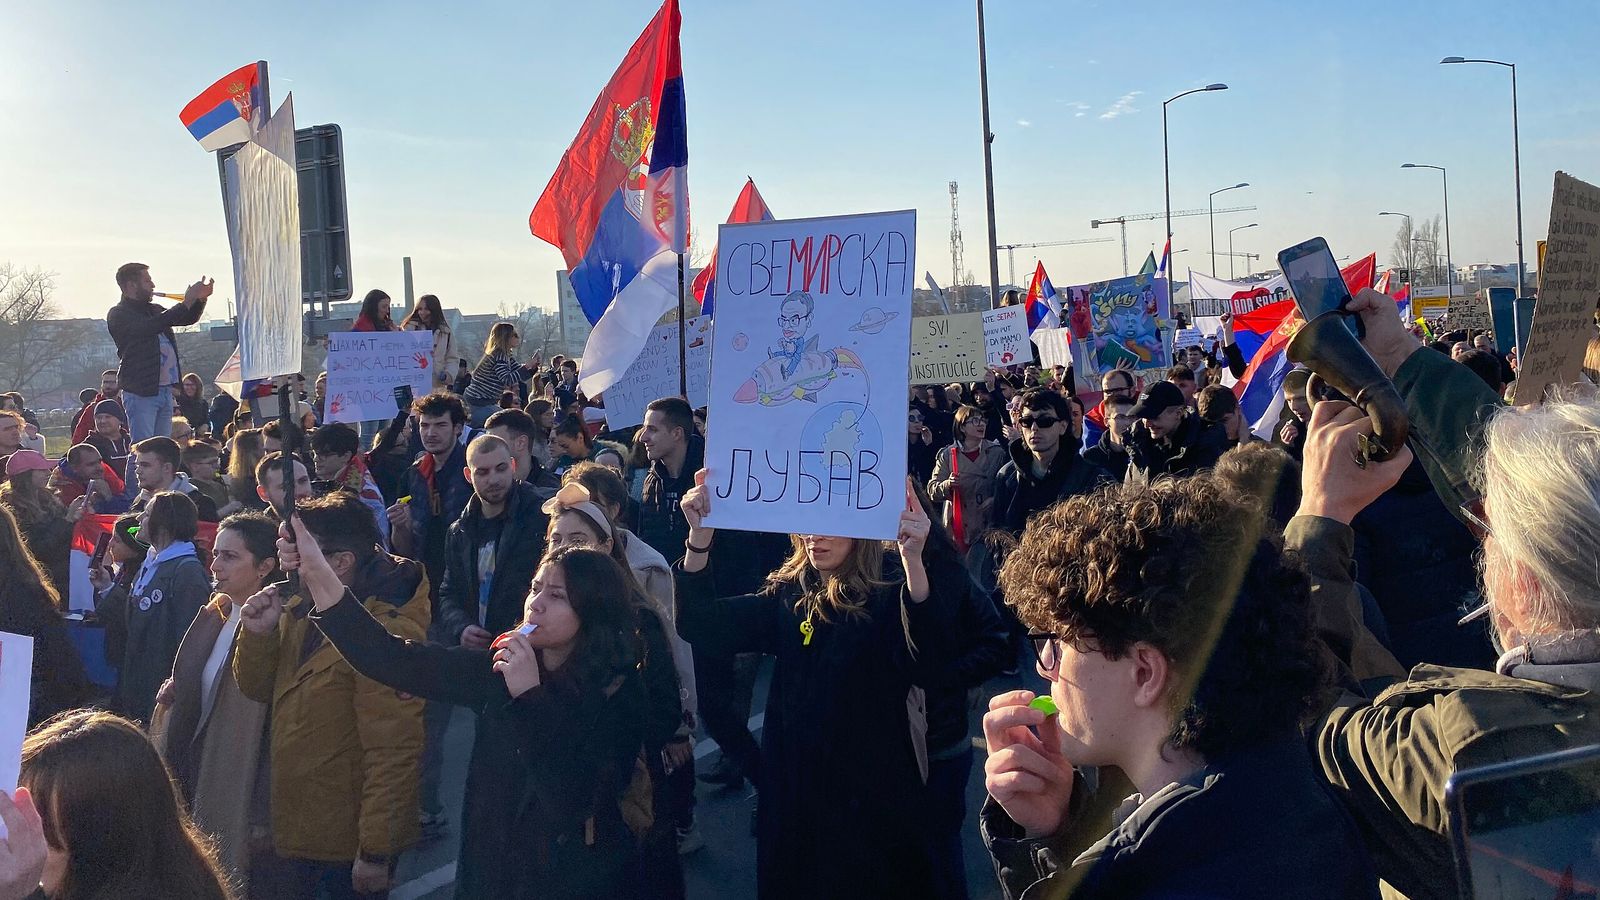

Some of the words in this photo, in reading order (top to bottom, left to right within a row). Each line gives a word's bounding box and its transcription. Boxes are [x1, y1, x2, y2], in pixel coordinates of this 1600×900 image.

[727, 231, 908, 298] СВЕМИРСКА
[929, 319, 950, 337] SVI
[328, 338, 377, 352] ШАХМАТ
[627, 373, 652, 386] TIRED
[915, 361, 979, 380] INSTITUCIJE
[716, 449, 884, 510] ЉУБАВ
